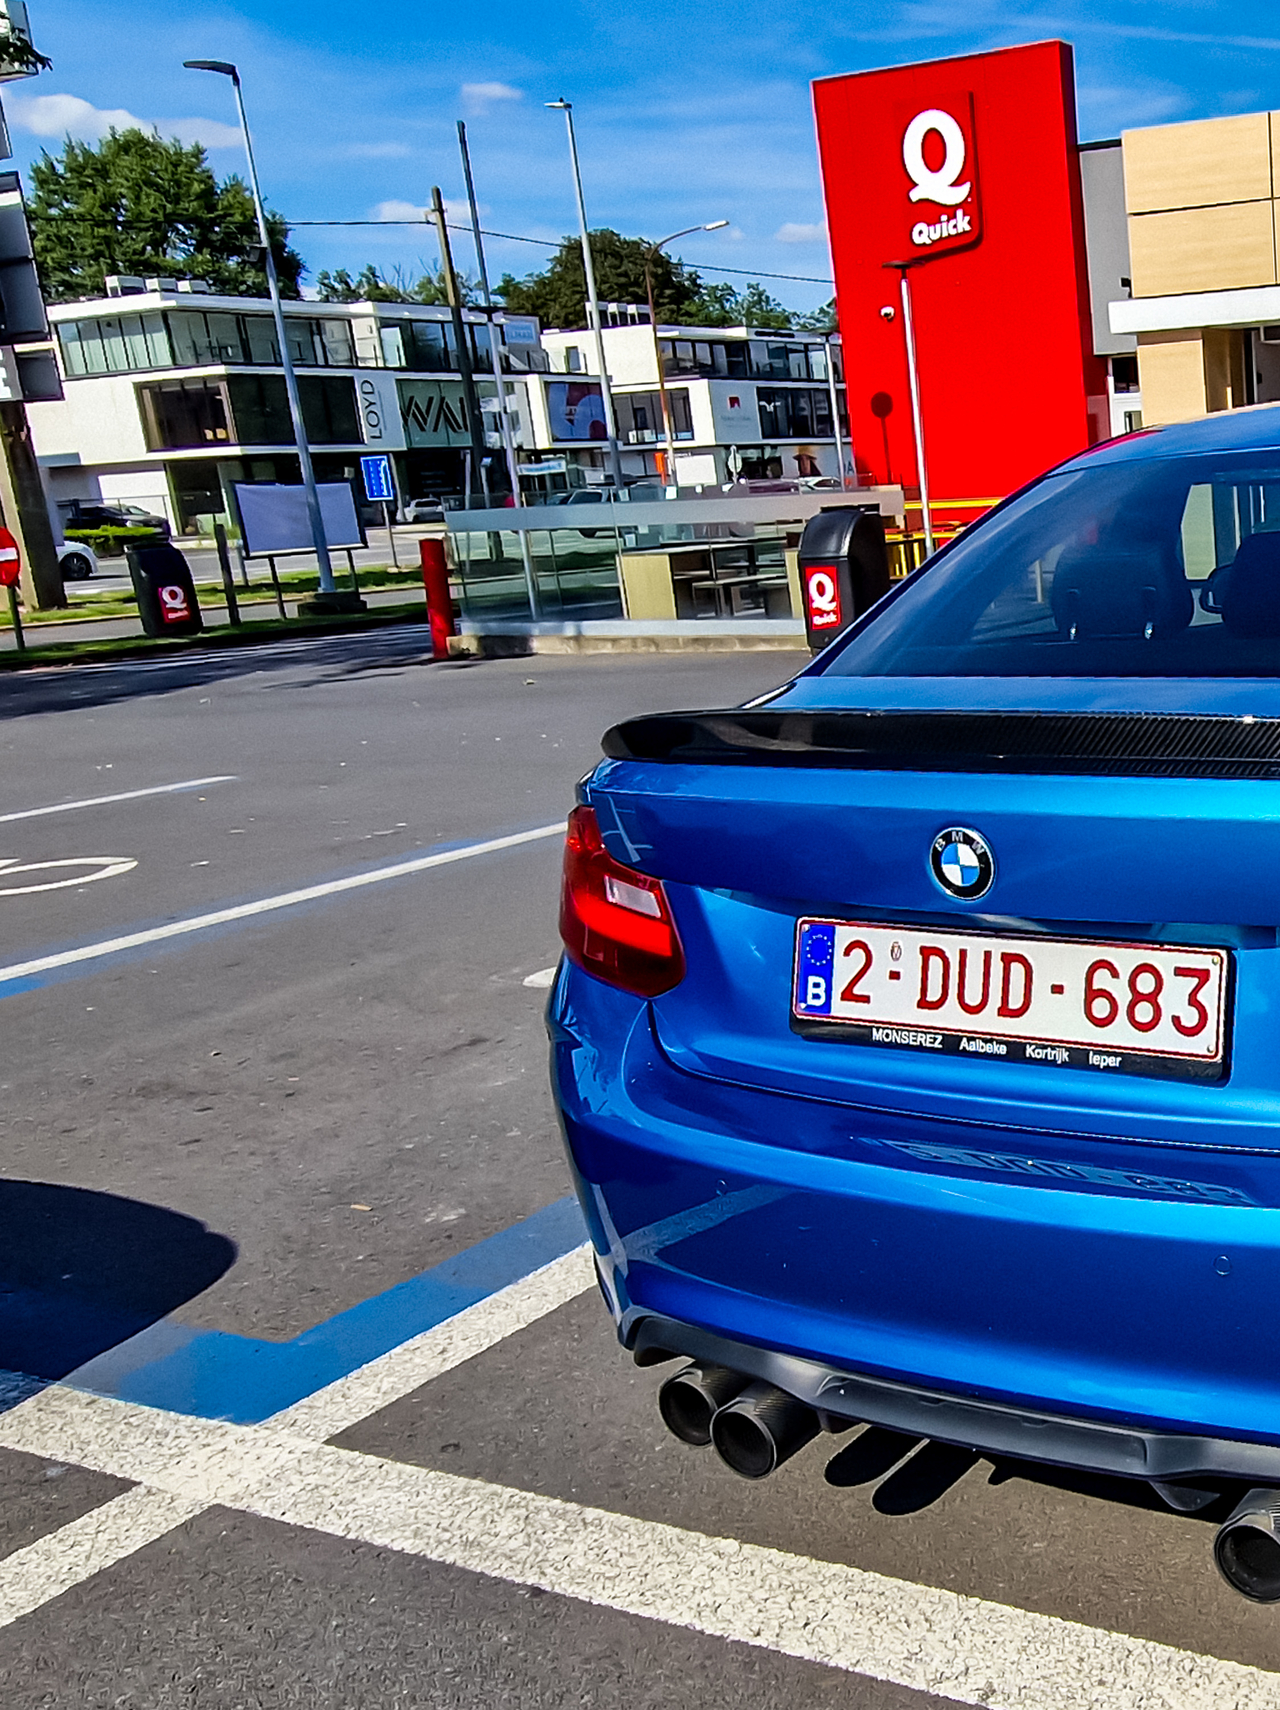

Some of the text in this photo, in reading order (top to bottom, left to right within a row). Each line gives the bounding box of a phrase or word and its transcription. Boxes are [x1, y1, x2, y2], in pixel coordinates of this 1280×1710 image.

[903, 108, 971, 206] Q
[912, 208, 971, 245] Quick
[360, 379, 383, 440] LOYD
[809, 572, 837, 611] Q
[934, 830, 985, 855] BMW
[807, 940, 1211, 1038] B 2-DUD-683
[872, 1027, 1122, 1069] MONSEREZ Aalbeke Kortrijk Ieper
